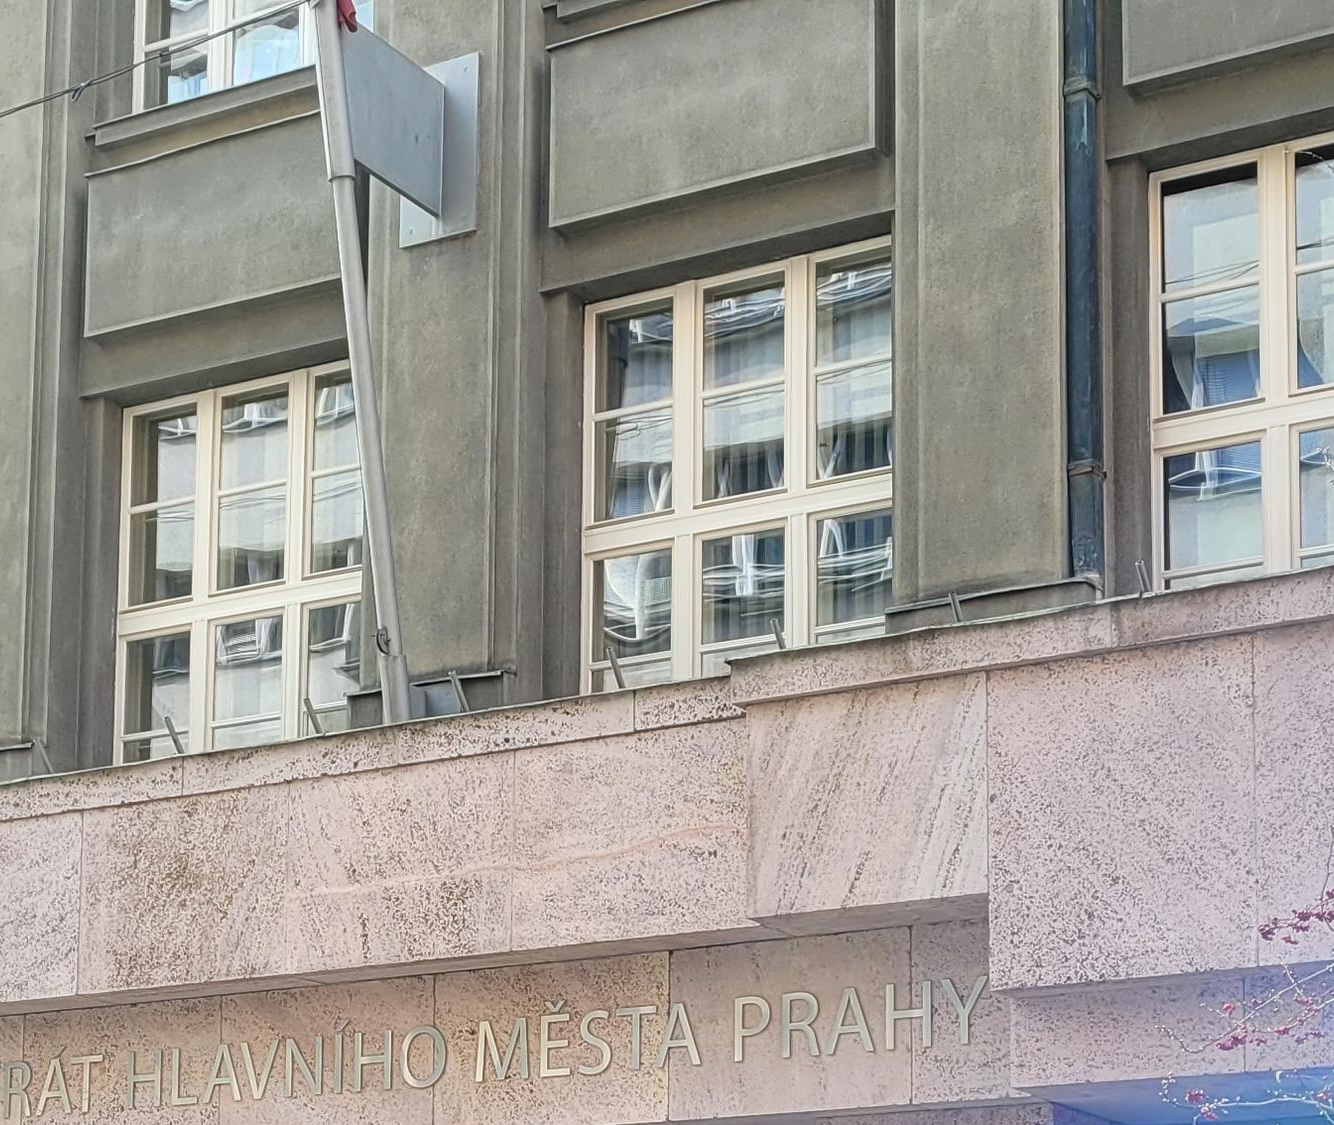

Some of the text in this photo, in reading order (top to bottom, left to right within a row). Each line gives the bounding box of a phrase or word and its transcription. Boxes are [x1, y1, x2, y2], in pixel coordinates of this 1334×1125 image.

[124, 1018, 448, 1111] HLAVNÍHO
[475, 1000, 703, 1083] MĚSTA
[733, 975, 990, 1063] PRAHY
